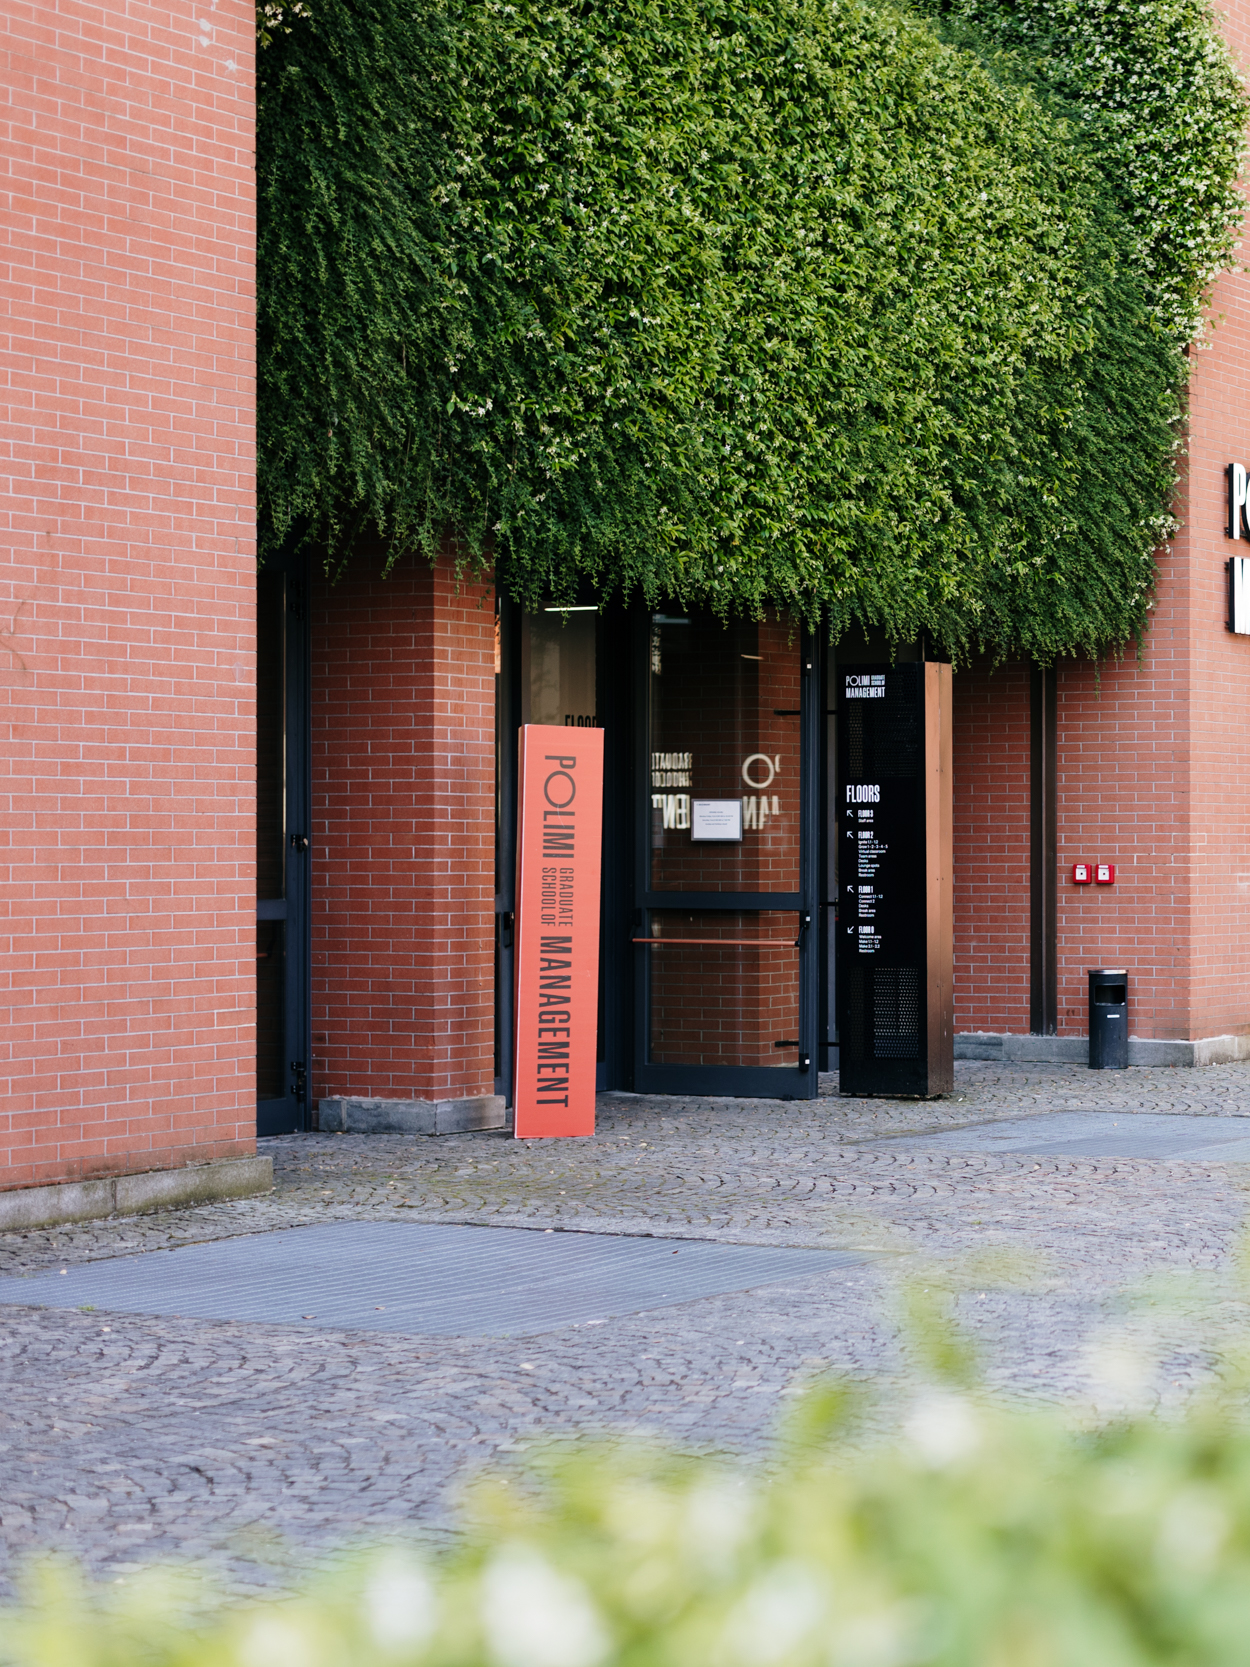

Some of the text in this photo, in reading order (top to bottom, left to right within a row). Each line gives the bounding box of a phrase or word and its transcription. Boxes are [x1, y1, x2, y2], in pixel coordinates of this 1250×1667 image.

[845, 675, 870, 686] POLIMI
[845, 687, 886, 698] MANAGEMENT
[542, 755, 577, 858] POLIMI
[846, 784, 881, 803] FLOORS
[540, 867, 558, 927] SCHOOL OF
[558, 867, 575, 928] GRADUATE
[536, 936, 573, 1108] MANAGEMENT
